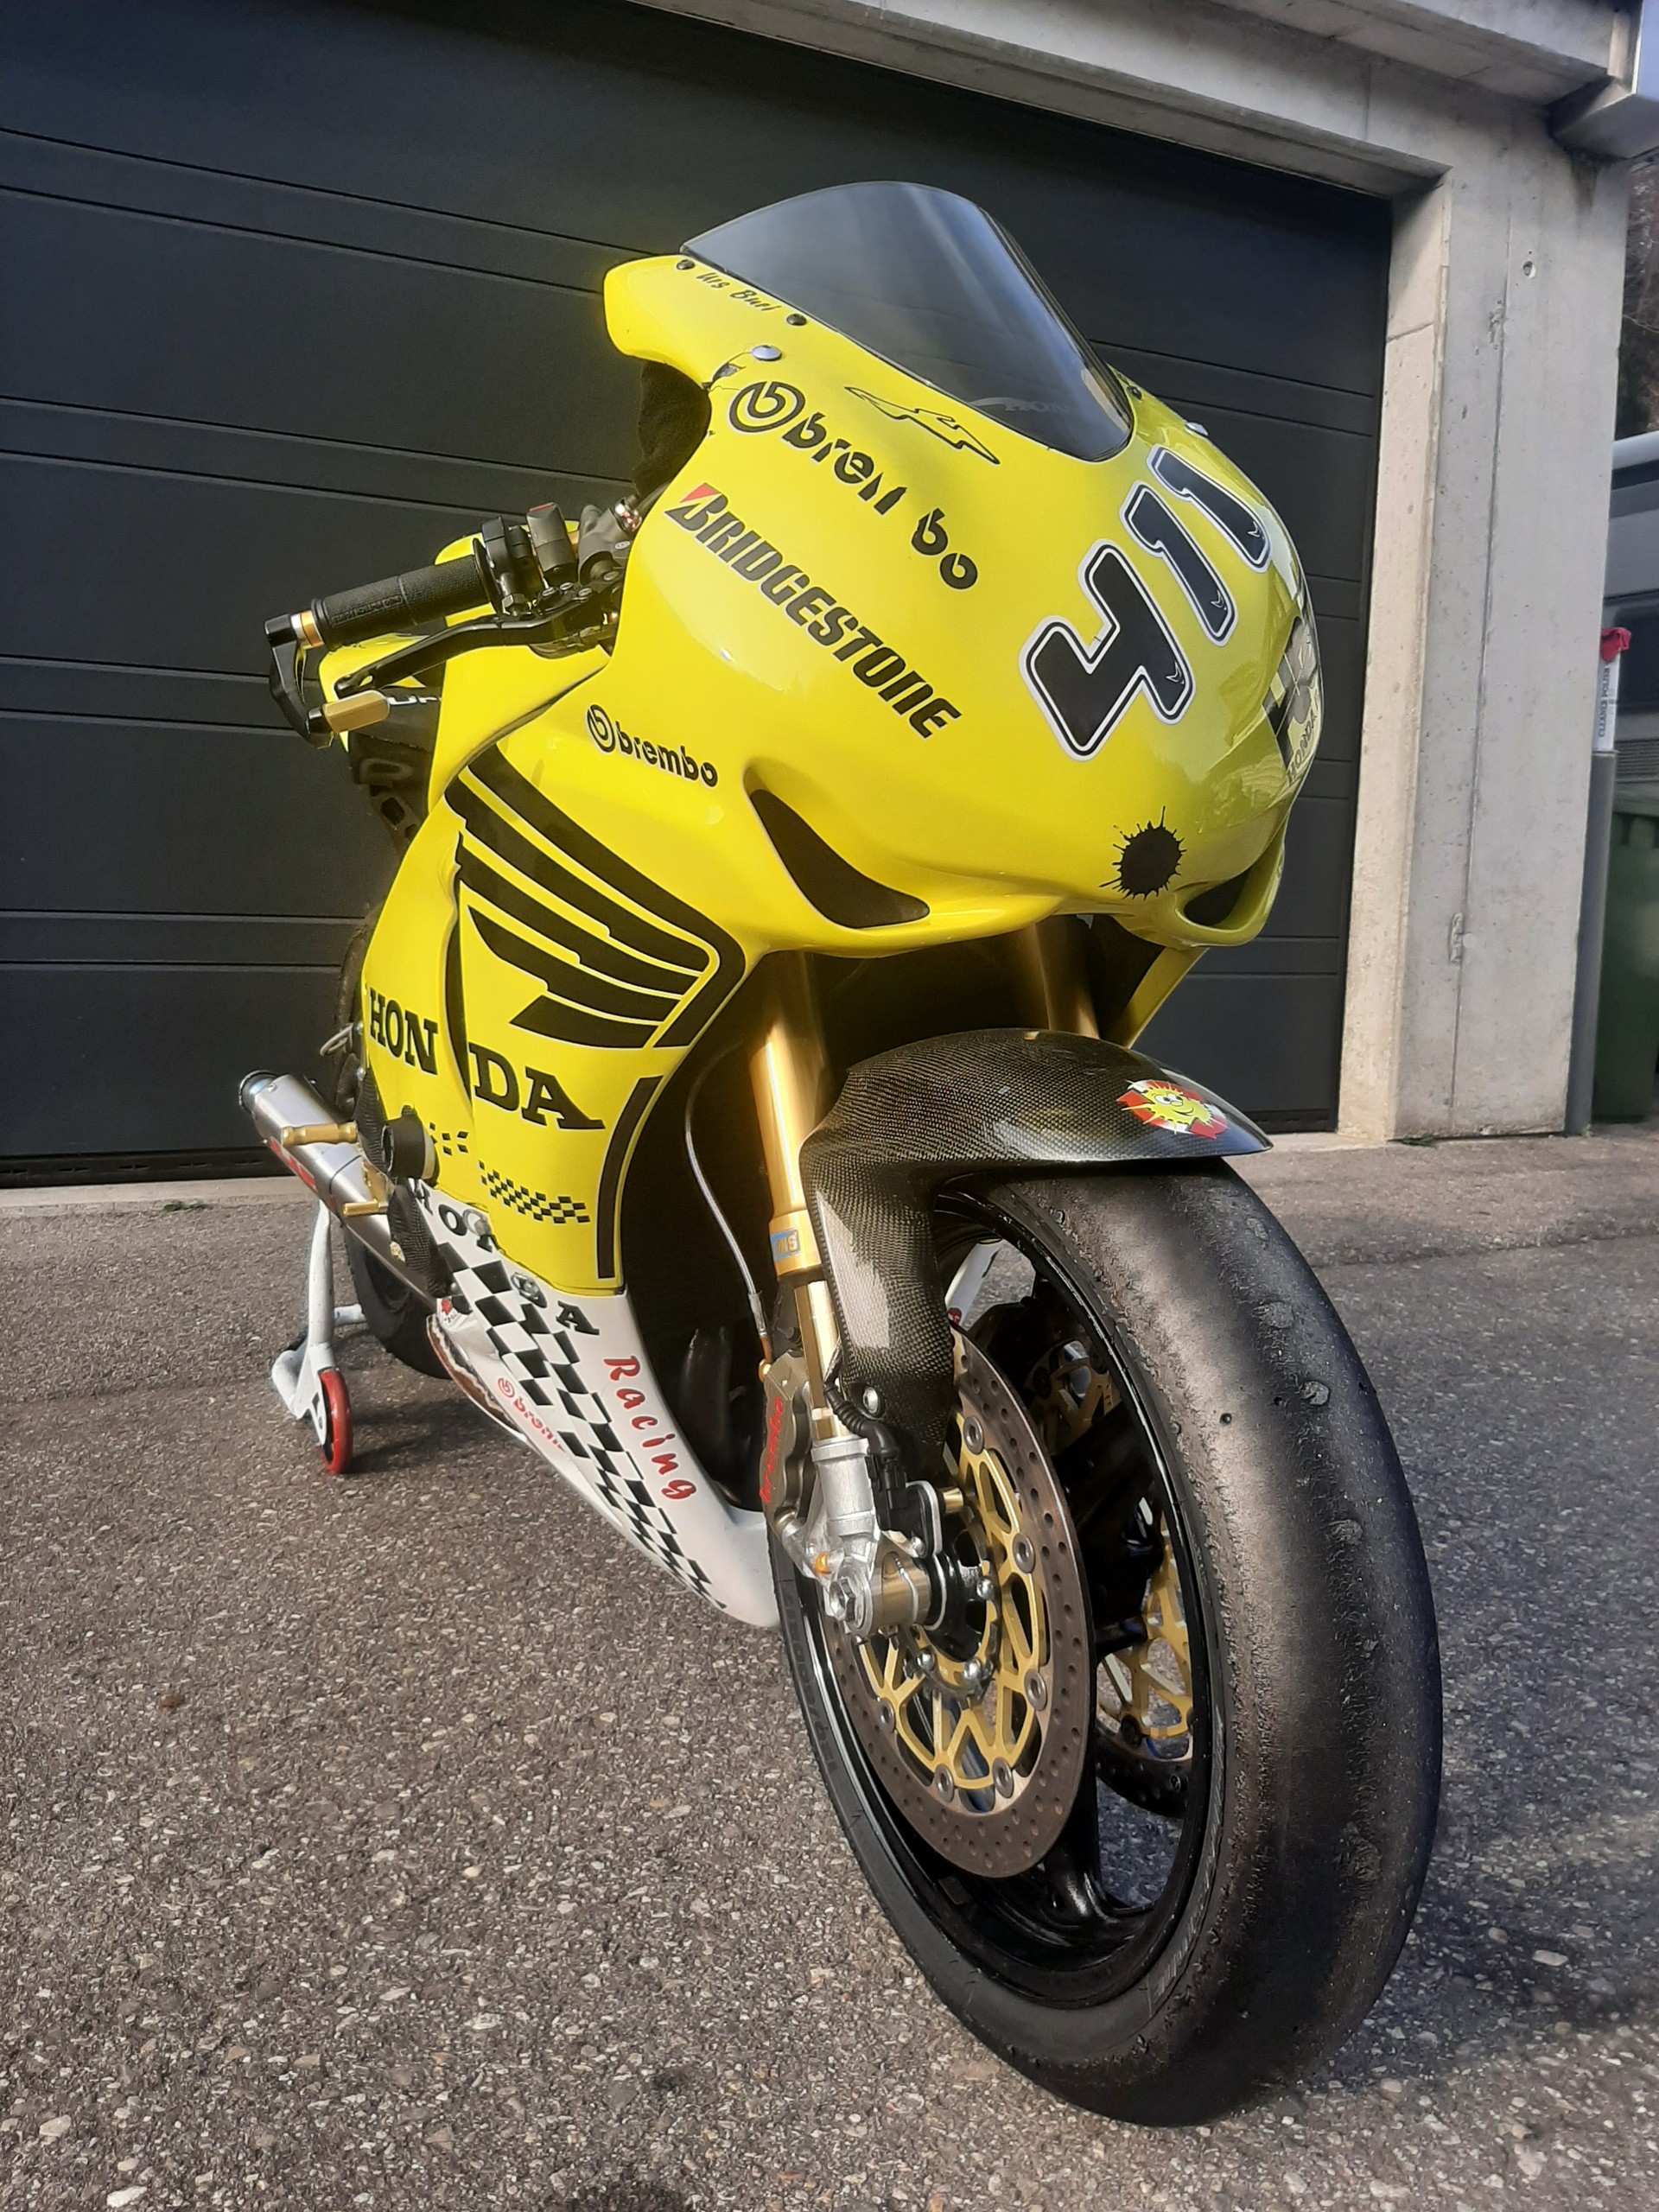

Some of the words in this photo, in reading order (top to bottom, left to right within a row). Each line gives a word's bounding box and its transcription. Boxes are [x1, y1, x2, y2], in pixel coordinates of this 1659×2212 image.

[664, 482, 963, 740] BRIDGESTONE
[614, 720, 719, 788] brembo
[604, 1355, 697, 1501] Racing
